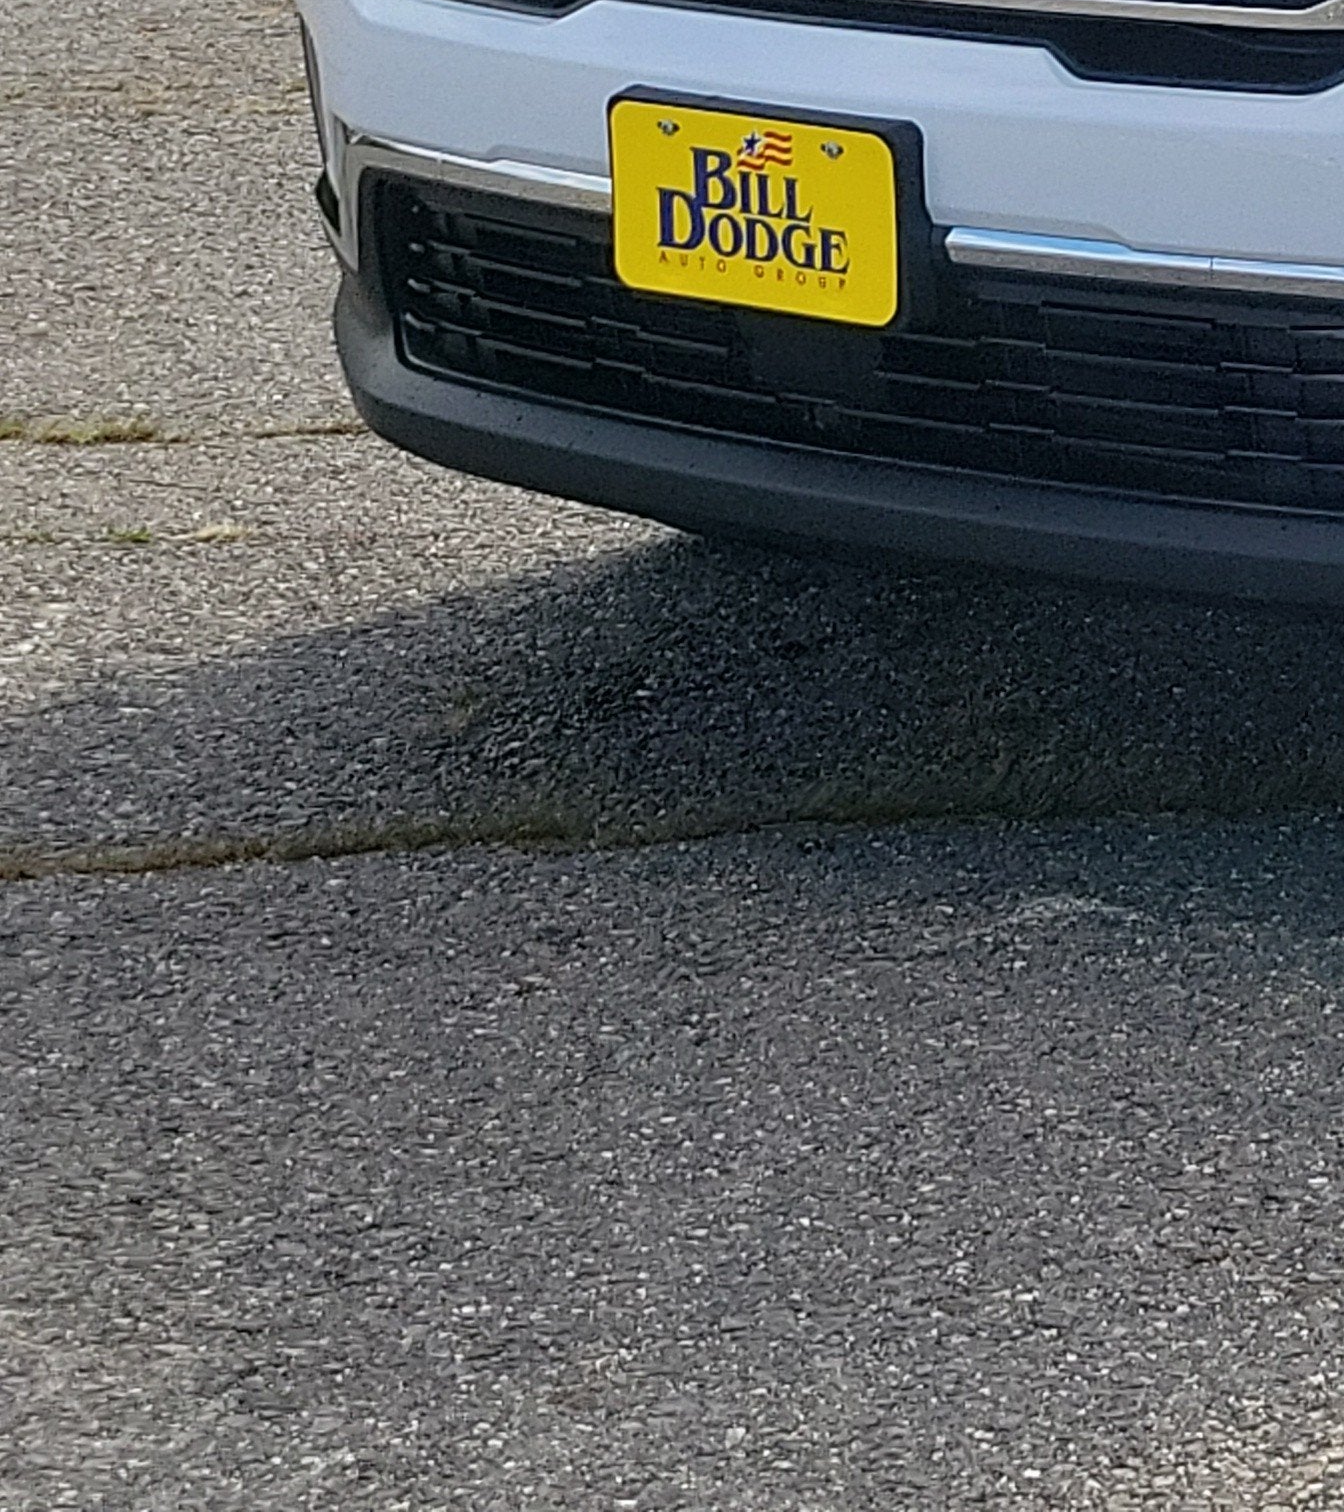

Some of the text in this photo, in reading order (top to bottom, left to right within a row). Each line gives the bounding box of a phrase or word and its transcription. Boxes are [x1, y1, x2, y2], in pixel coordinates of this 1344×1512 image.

[690, 146, 814, 223] BILL
[656, 186, 850, 274] DODGE
[659, 250, 847, 289] AUTO GROUP
